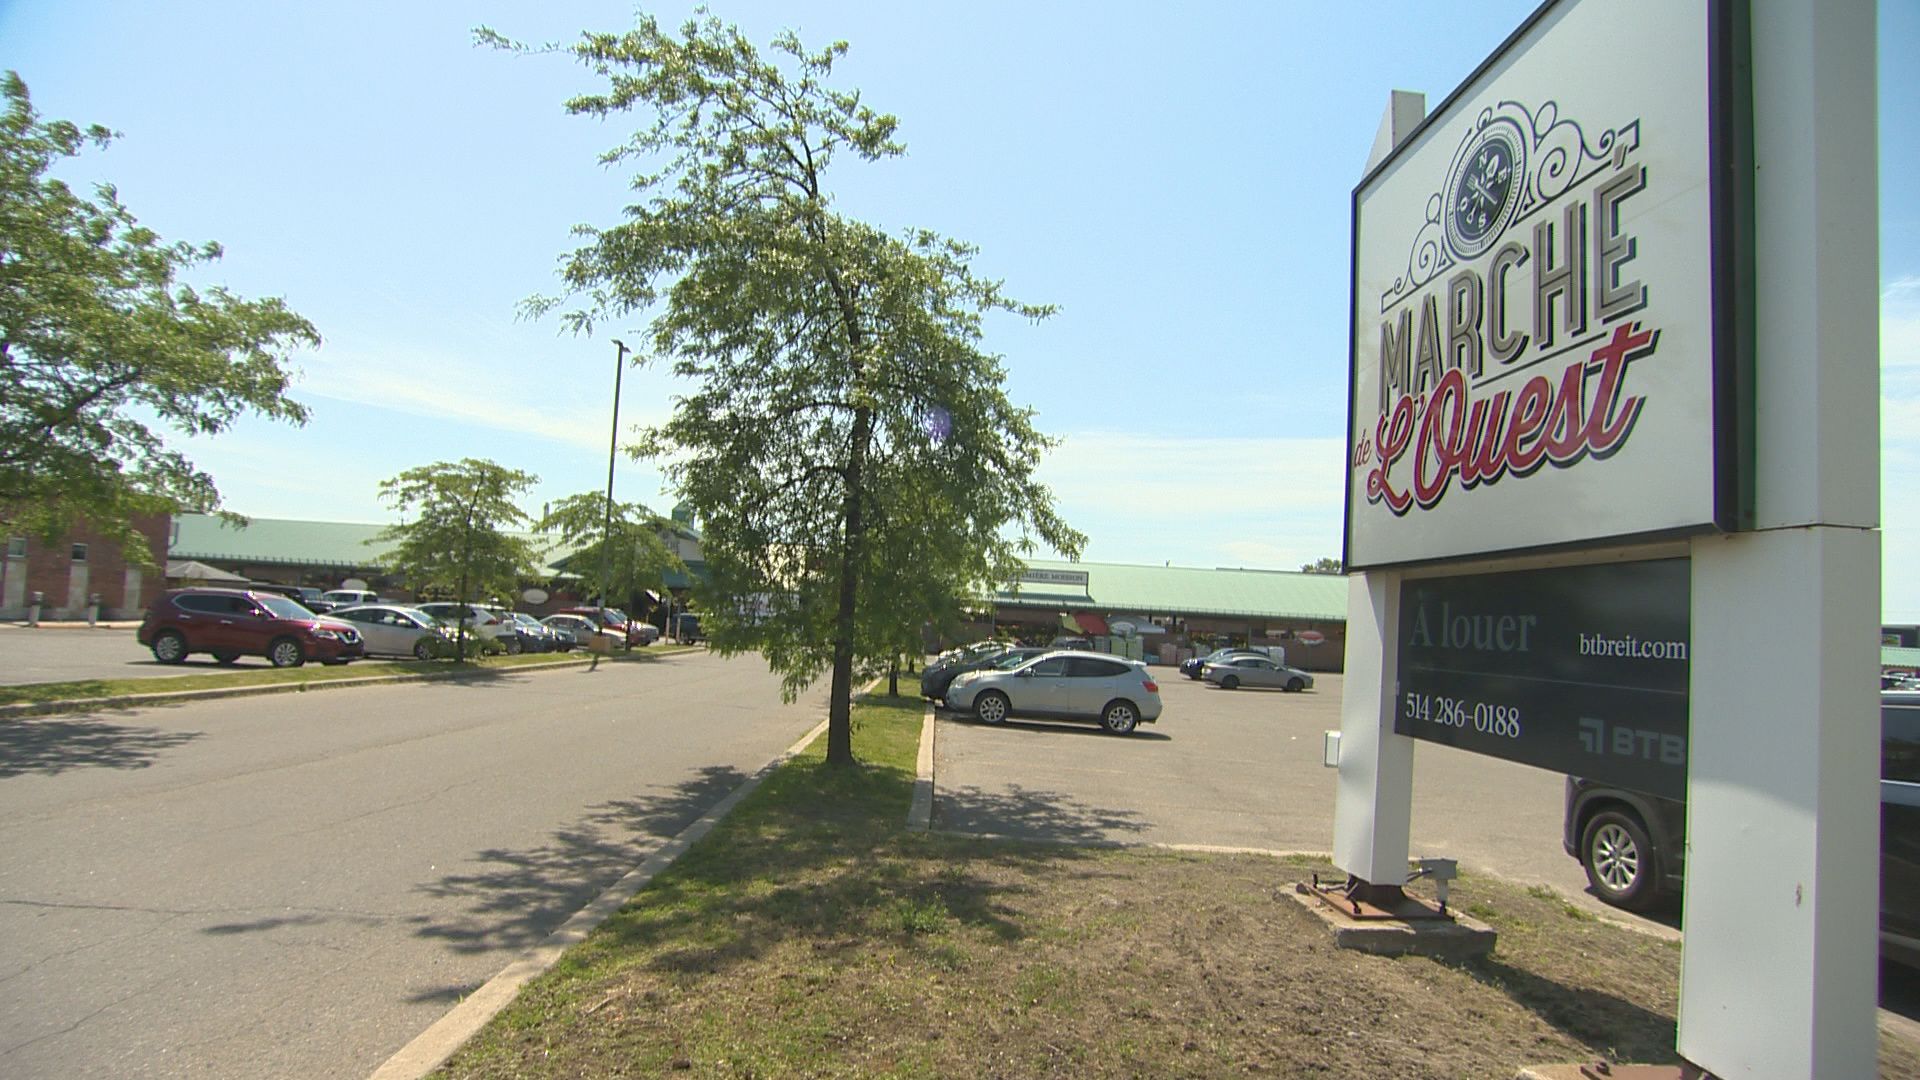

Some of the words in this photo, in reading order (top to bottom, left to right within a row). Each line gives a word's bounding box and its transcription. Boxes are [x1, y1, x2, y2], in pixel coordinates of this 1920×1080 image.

[1478, 149, 1489, 169] N
[1497, 167, 1507, 184] E
[1478, 214, 1487, 229] S
[1379, 144, 1647, 415] MARCHÉ
[1354, 428, 1371, 468] de
[1367, 321, 1656, 515] L'Ouest
[1408, 589, 1434, 648] À
[1441, 600, 1537, 652] louer
[1579, 633, 1687, 660] btbreit.com
[1406, 692, 1430, 722] 514
[1434, 696, 1521, 738] 286-0188
[1612, 726, 1685, 766] BTB
